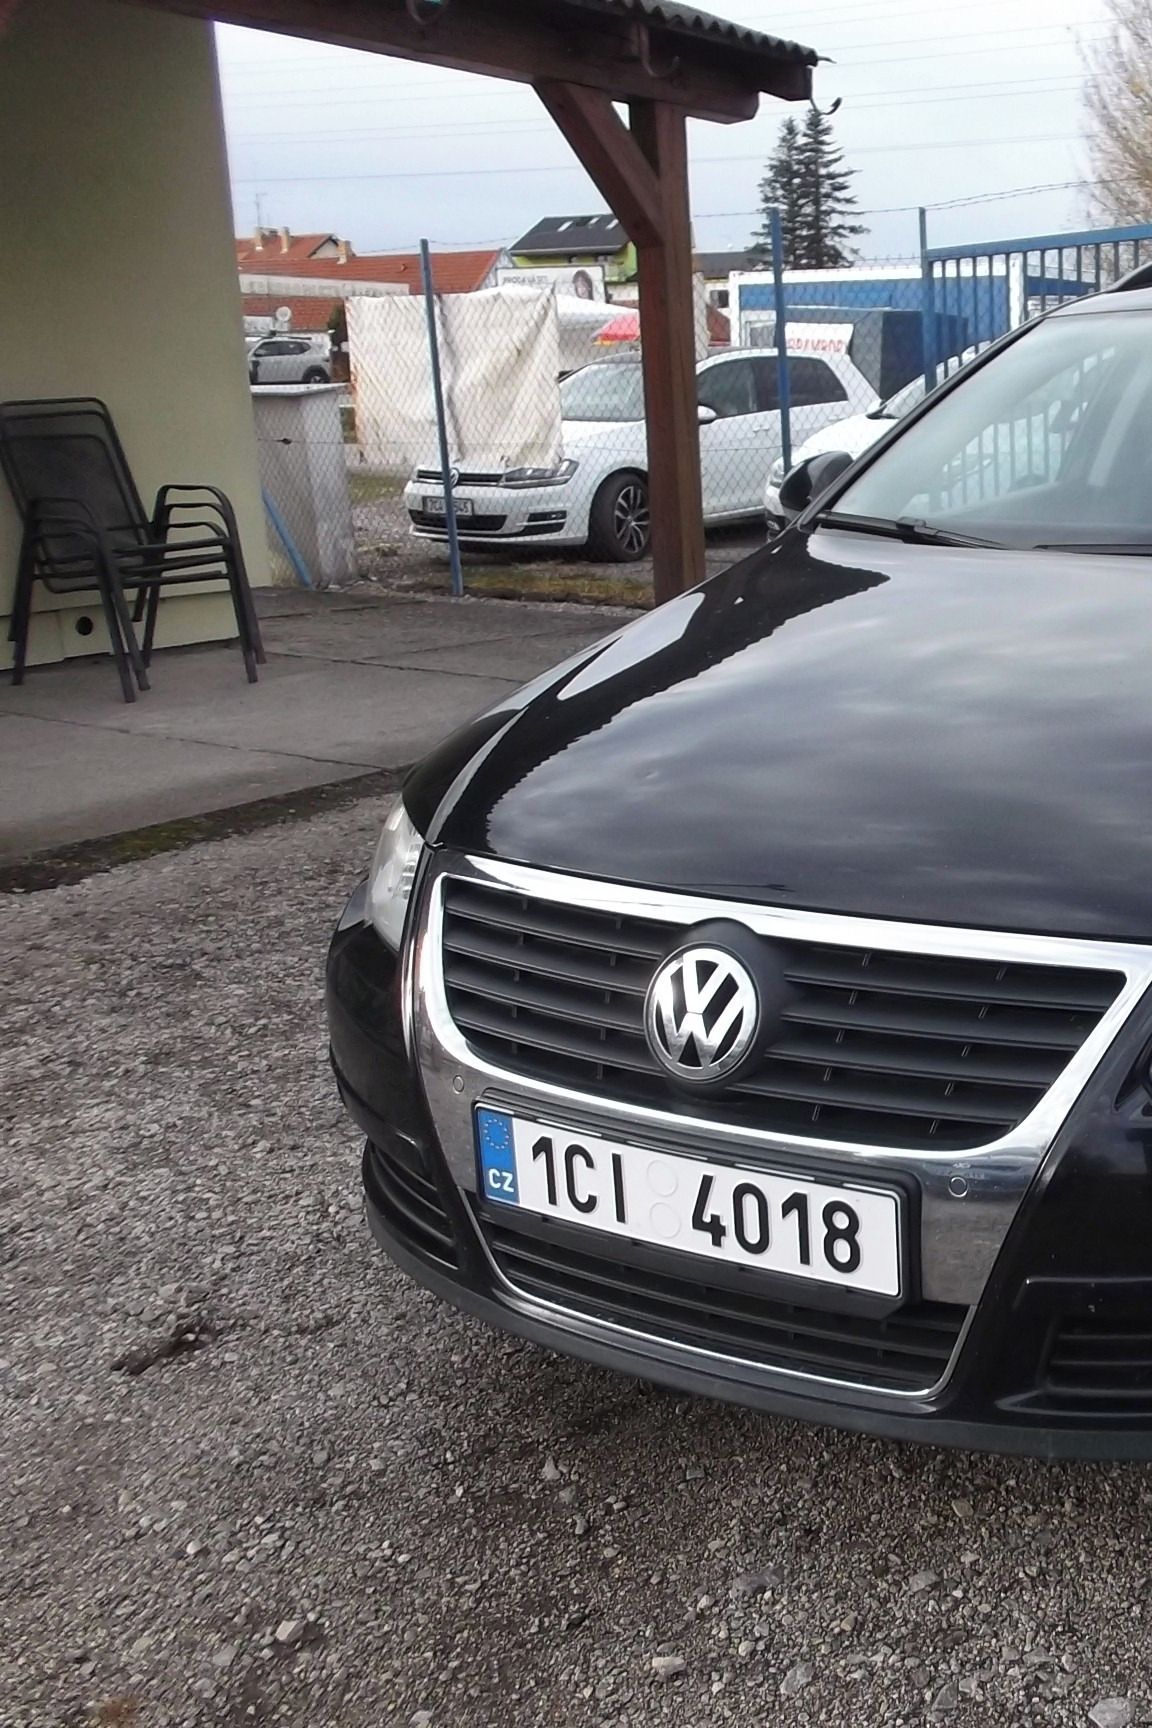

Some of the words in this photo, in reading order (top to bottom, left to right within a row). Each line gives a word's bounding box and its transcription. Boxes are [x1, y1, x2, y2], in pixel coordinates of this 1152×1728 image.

[649, 947, 757, 1080] VW
[488, 1168, 514, 1193] CZ
[531, 1136, 626, 1224] 1CI
[691, 1174, 861, 1274] 4018
